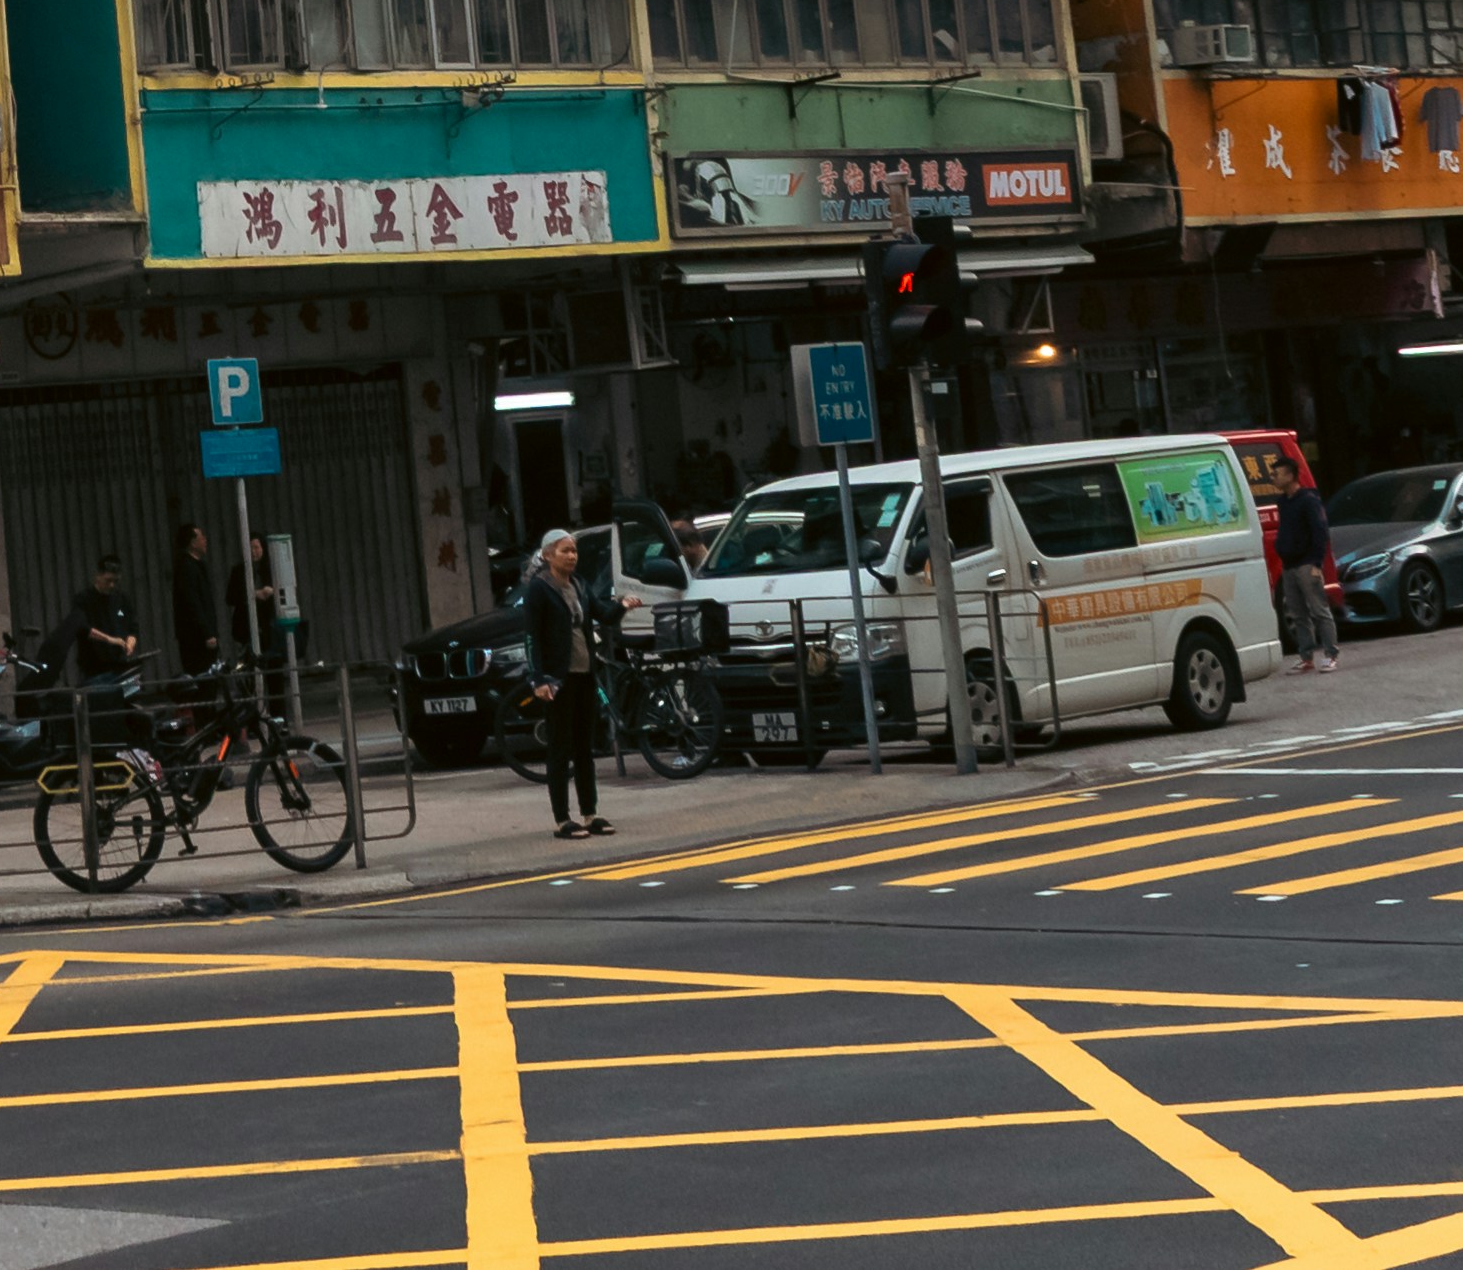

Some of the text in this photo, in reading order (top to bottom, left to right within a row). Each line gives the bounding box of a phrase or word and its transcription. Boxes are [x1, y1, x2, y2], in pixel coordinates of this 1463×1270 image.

[989, 168, 1066, 199] MOTUL
[242, 180, 573, 250] 鴻利五金電器
[820, 199, 845, 222] KY
[831, 364, 846, 377] NO
[218, 366, 250, 417] P
[825, 380, 855, 395] ENTRY
